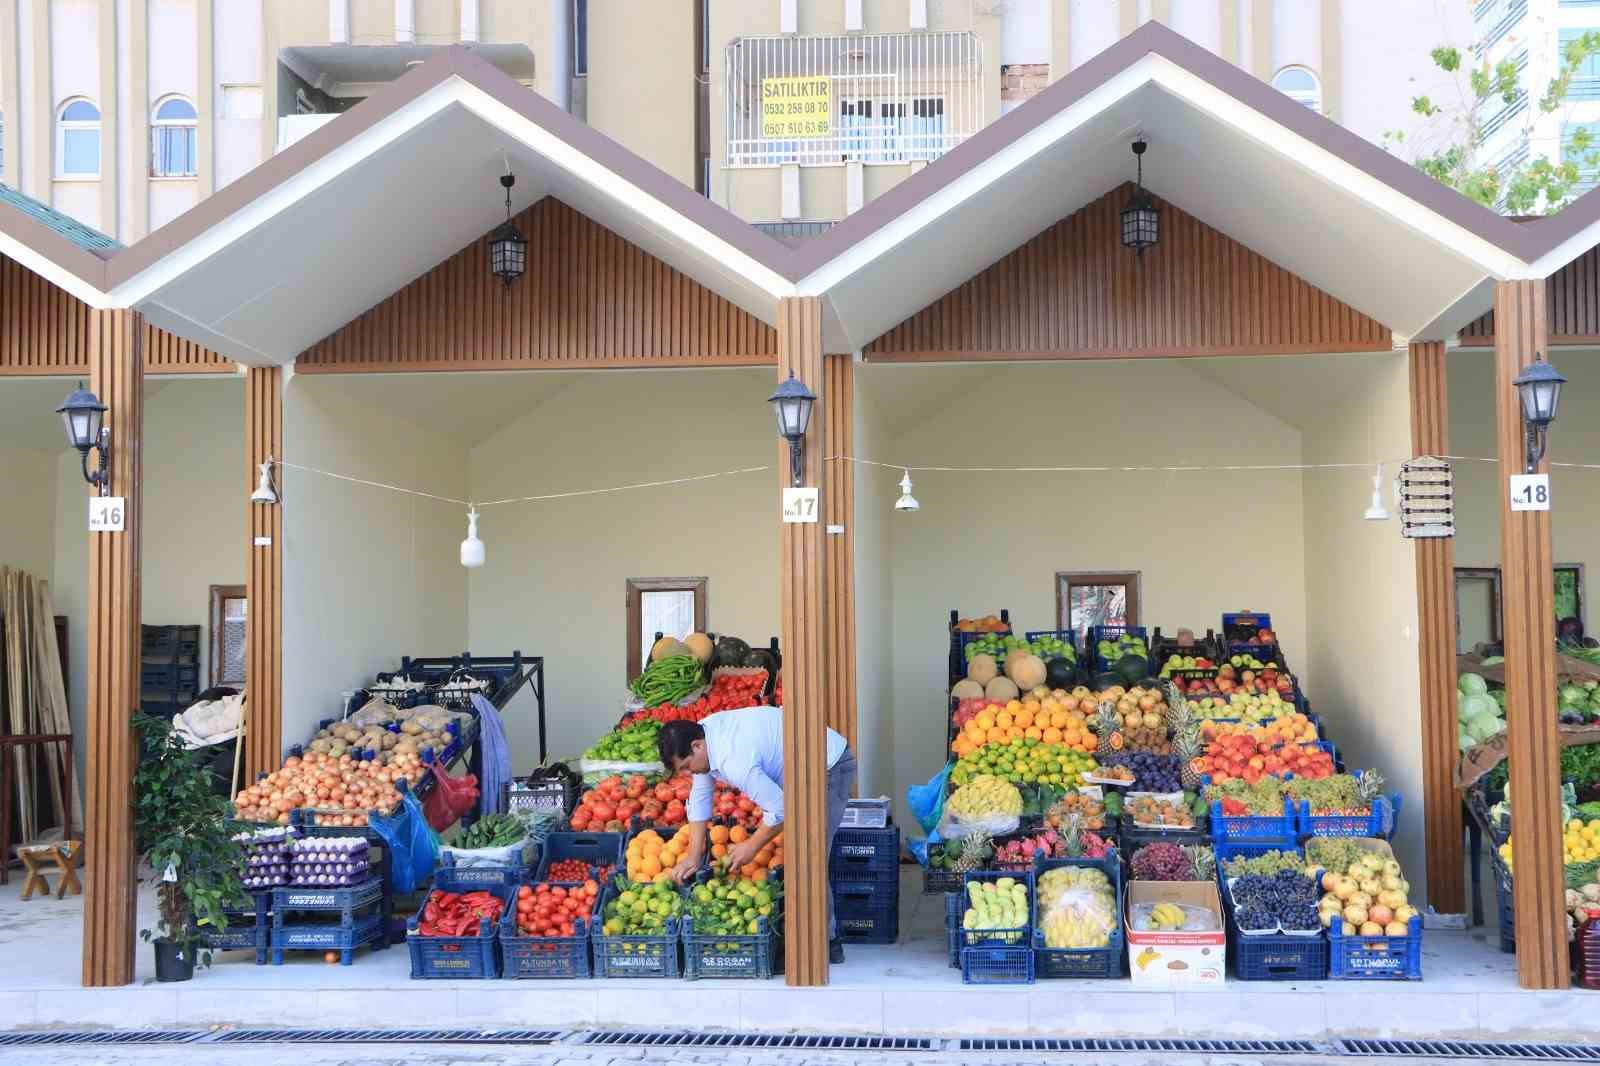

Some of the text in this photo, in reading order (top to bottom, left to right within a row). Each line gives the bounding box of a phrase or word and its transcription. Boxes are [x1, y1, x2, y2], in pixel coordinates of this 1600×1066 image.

[764, 81, 828, 98] SATILIKTIR
[764, 103, 785, 115] 0532
[818, 101, 829, 113] 70
[764, 123, 785, 135] 0507
